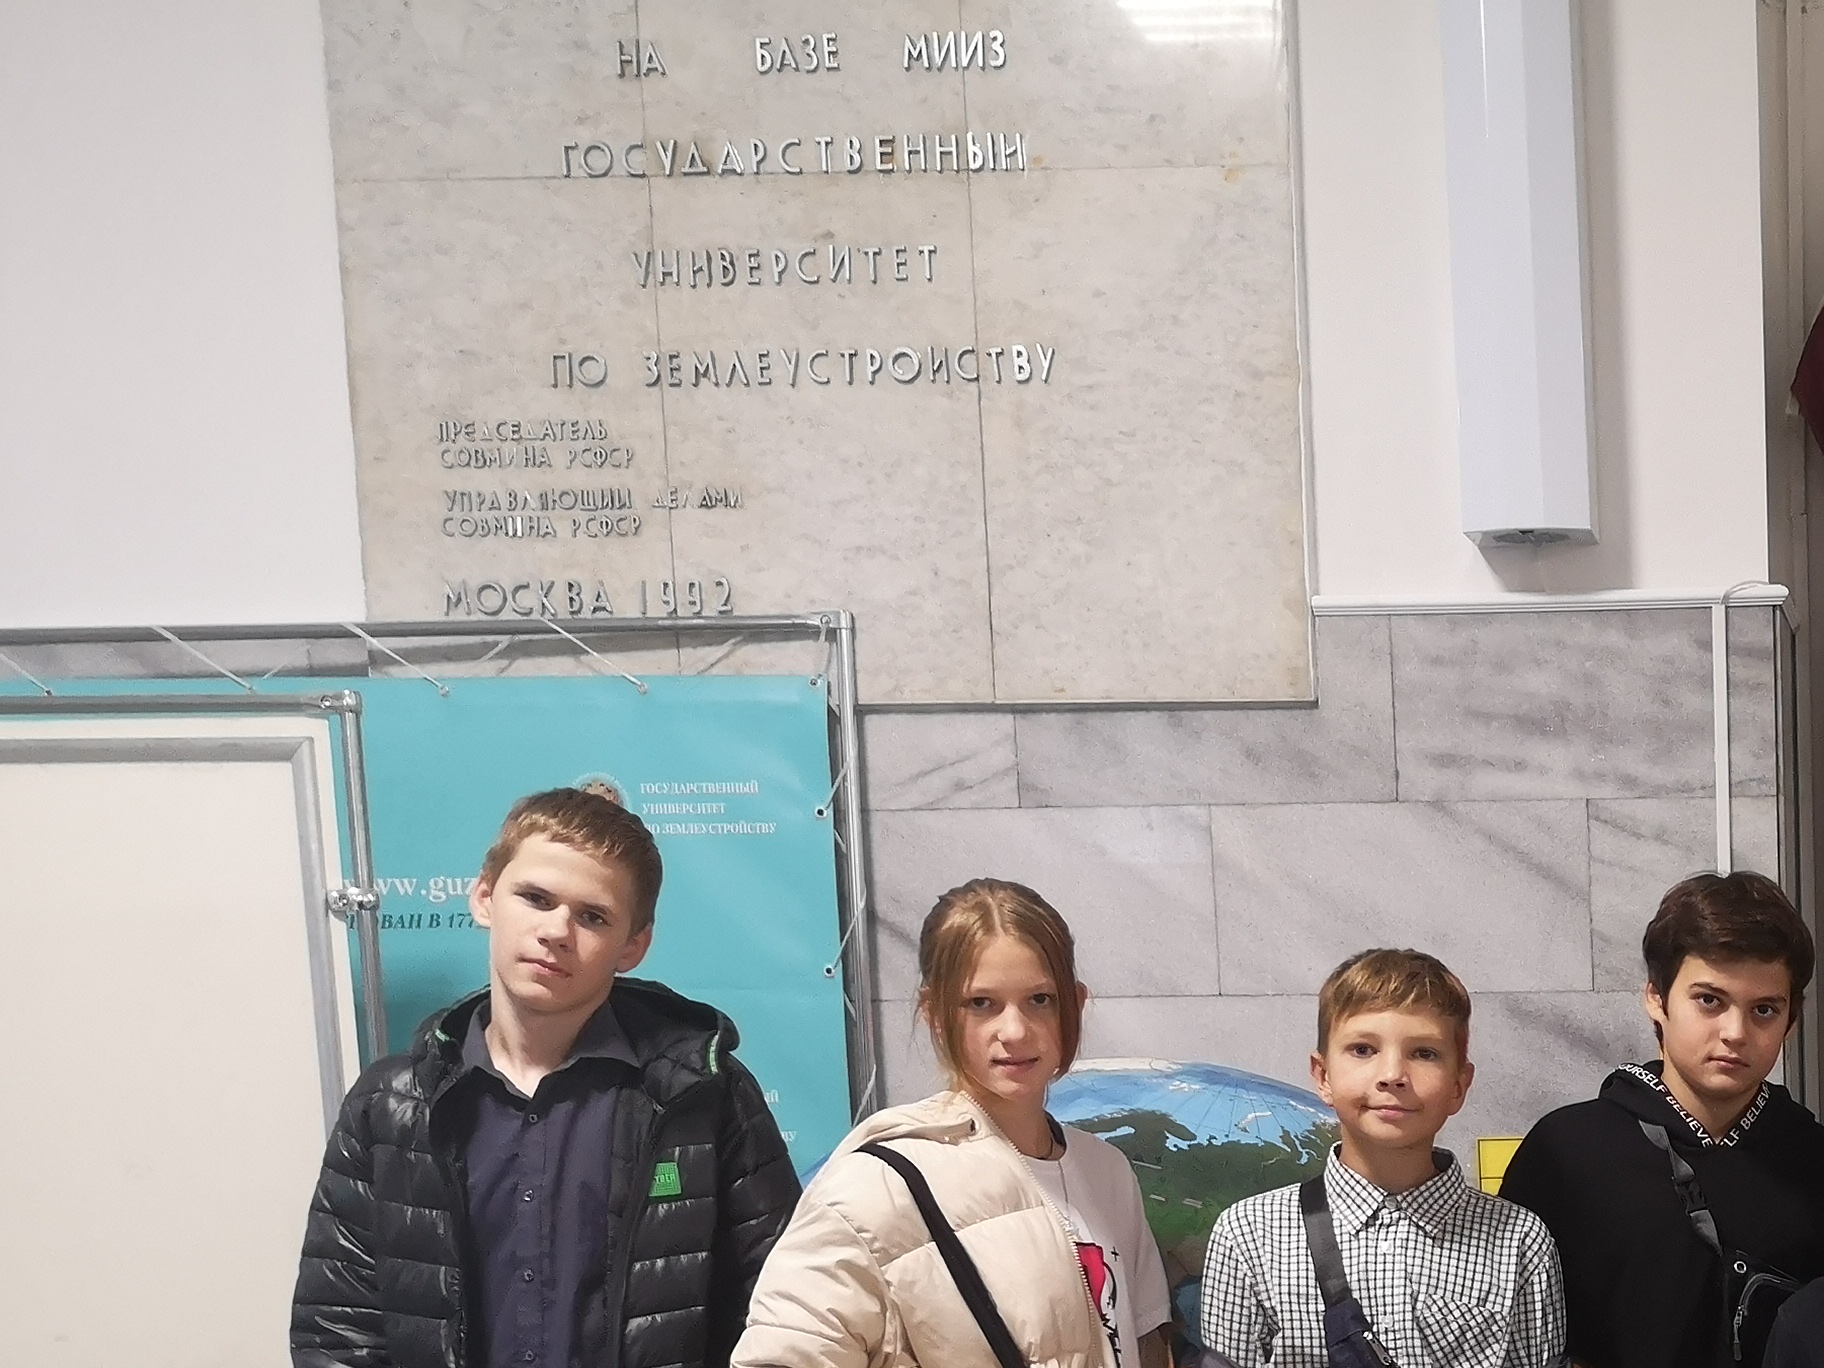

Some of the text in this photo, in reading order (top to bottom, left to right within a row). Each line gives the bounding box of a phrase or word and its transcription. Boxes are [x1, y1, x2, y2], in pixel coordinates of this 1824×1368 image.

[617, 29, 1007, 77] НА БАЗЕ МИИЗ
[632, 244, 938, 288] УНИВЕРСИТЕТ
[551, 350, 609, 389] ПО
[438, 420, 608, 442] ПРЕДСЕДАТЕЛЬ
[440, 446, 634, 469] СОВМИНА РСФСР
[441, 514, 642, 538] СОВМИНА РСФСР
[444, 577, 735, 617] МОСКВА 1992
[640, 779, 760, 794] ГОСУДАРСТВЕННЫЙ
[642, 802, 726, 815] УНИВЕРСИТЕТ
[663, 820, 777, 835] ЗЕМЛЕУСТРОЙСТВУ
